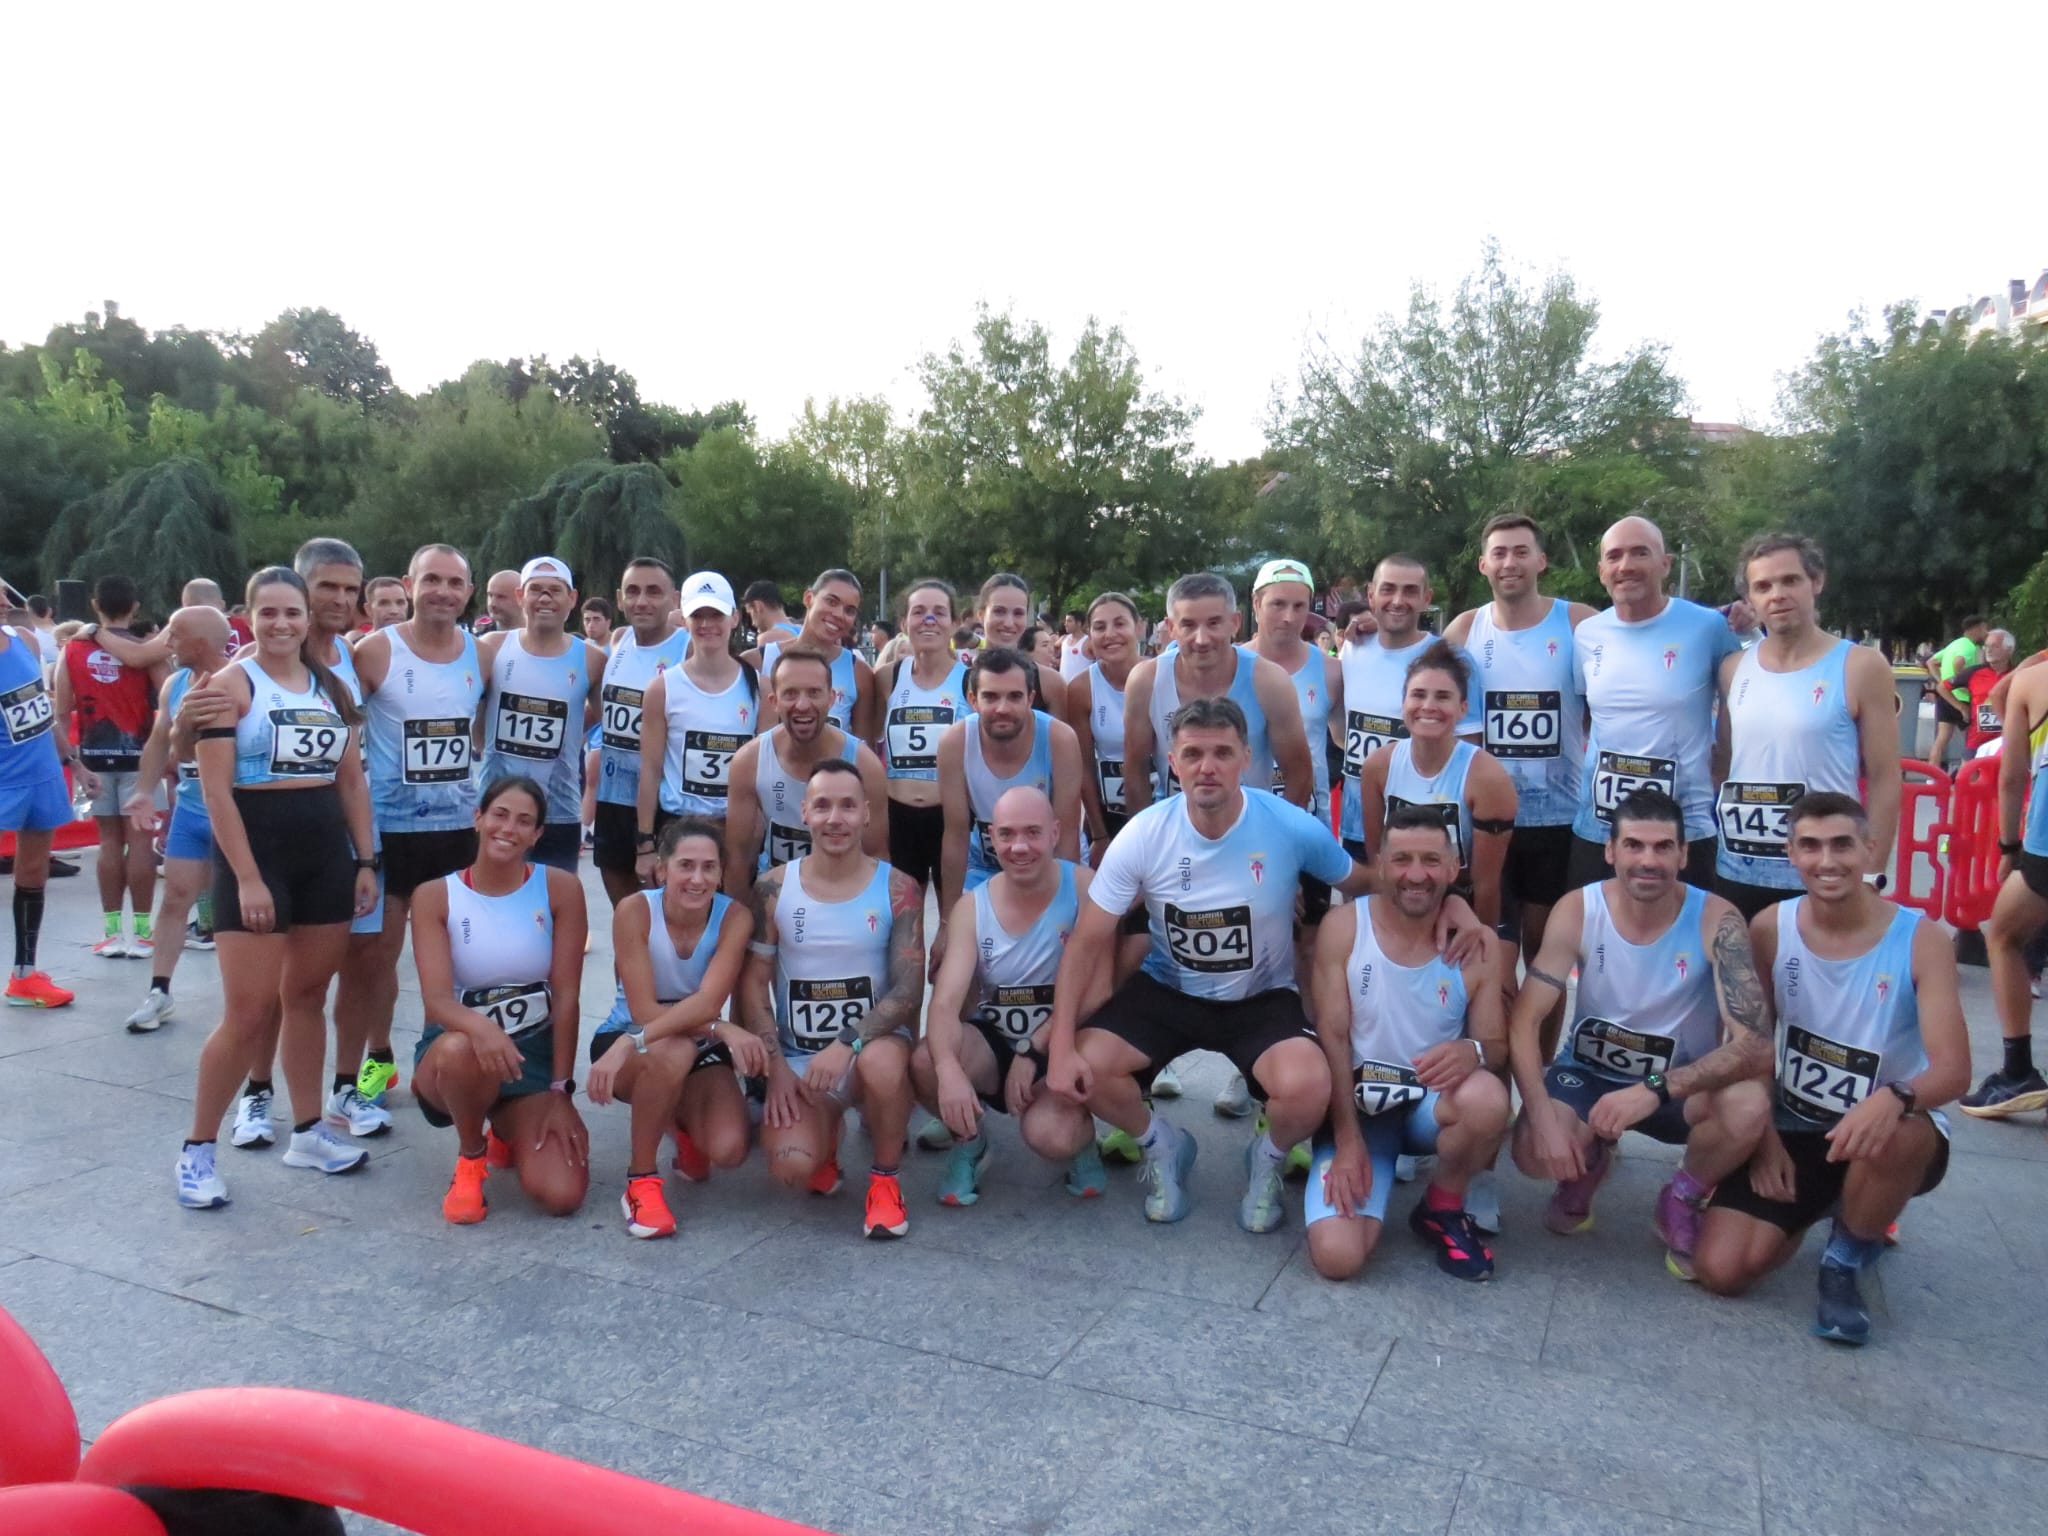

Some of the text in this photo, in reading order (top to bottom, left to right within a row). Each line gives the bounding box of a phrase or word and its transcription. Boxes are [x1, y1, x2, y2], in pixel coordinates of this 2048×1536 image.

[1484, 639, 1494, 669] evelb
[505, 713, 554, 743] 113
[908, 726, 927, 751] 5
[1491, 712, 1553, 740] 160
[293, 728, 336, 758] 39
[413, 738, 465, 765] 179
[1347, 732, 1399, 759] 20
[772, 781, 785, 812] evelb
[1726, 806, 1788, 838] 143
[1178, 857, 1191, 891] evelb
[461, 917, 471, 945] evelb
[792, 907, 806, 944] evelb
[1170, 927, 1247, 956] 204
[1360, 963, 1372, 996] evelb
[1784, 956, 1800, 998] evelb
[796, 1001, 863, 1033] 128
[1588, 1040, 1654, 1075] 161
[1789, 1056, 1858, 1109] 124
